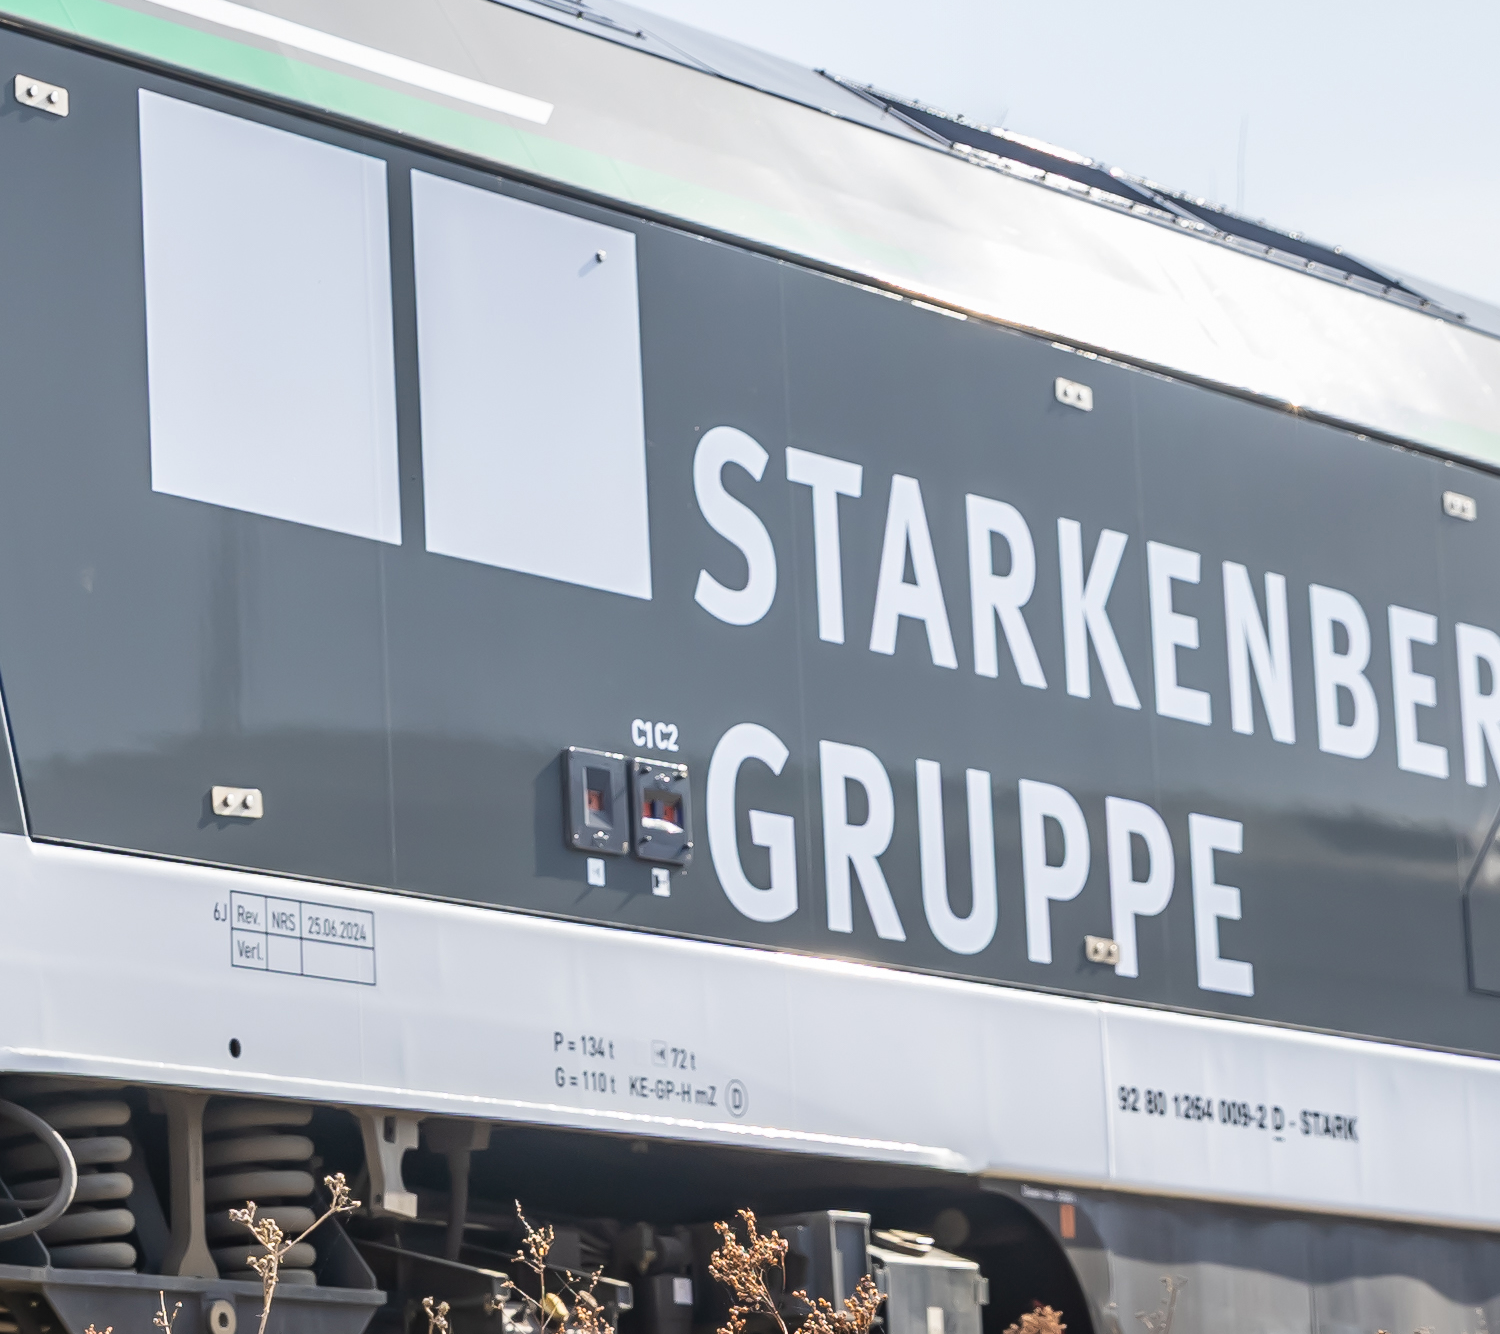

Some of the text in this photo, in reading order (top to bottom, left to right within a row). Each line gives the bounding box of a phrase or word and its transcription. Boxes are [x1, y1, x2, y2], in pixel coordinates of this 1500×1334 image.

[631, 718, 680, 753] C1 C2
[706, 723, 1255, 998] GRUPPE
[236, 905, 367, 942] Rev. NRS 25.06.2024
[236, 939, 264, 961] Verl.
[553, 1031, 564, 1052] P
[580, 1035, 605, 1059] 134
[670, 1047, 688, 1070] 72
[554, 1066, 566, 1088] G
[582, 1070, 608, 1094] 110
[1118, 1085, 1140, 1112] 92
[1144, 1088, 1168, 1117] 80
[1300, 1109, 1359, 1142] STARK
